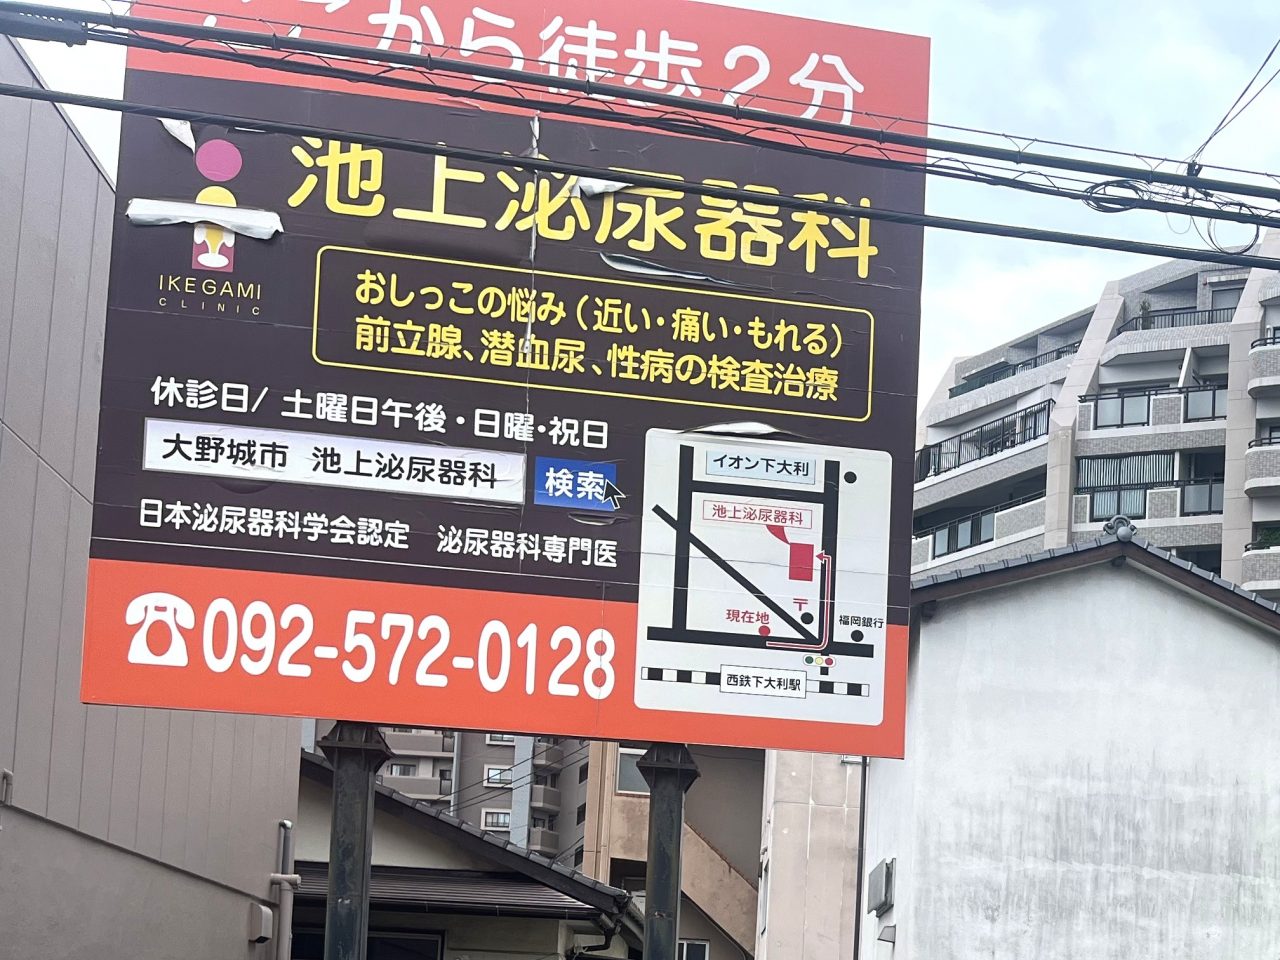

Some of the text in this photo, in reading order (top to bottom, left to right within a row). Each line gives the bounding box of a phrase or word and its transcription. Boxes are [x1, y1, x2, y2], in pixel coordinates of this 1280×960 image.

[203, 0, 864, 126] から徒歩2分
[287, 136, 879, 279] 池上泌尿器科
[159, 274, 262, 301] IKEGAMI
[158, 297, 261, 316] CLINIC
[355, 314, 839, 402] 前立腺、潜血尿、性病の検査治療
[281, 388, 609, 449] 土曜日午後・日曜・祝日
[162, 432, 498, 489] 大野城市 池上泌尿器科
[713, 454, 810, 477] イオン下大利
[545, 467, 605, 501] 検索
[711, 504, 804, 526] 池上泌尿器科
[139, 498, 618, 568] 日本泌尿器科学会認定 泌尿器科専門医
[726, 608, 770, 625] 現在地
[838, 614, 884, 629] 福岡銀行
[202, 597, 615, 700] 092-572-0128
[726, 673, 801, 691] 西鉄下大利駅
